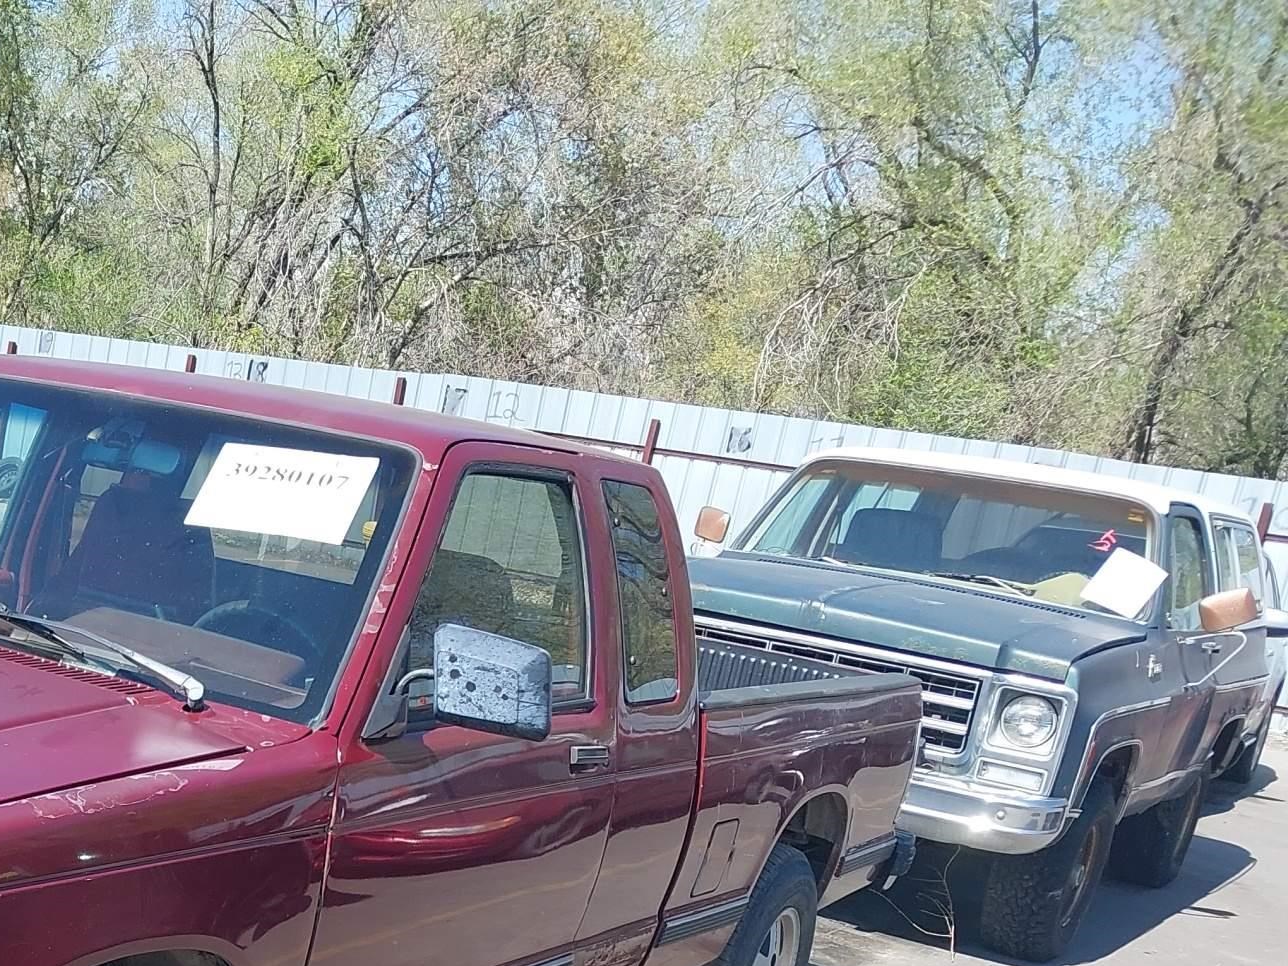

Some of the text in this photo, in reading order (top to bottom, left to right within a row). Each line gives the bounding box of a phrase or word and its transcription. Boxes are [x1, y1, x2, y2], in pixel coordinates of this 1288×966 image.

[487, 391, 528, 422] 12
[726, 426, 752, 453] 16
[225, 462, 350, 489] 39280107
